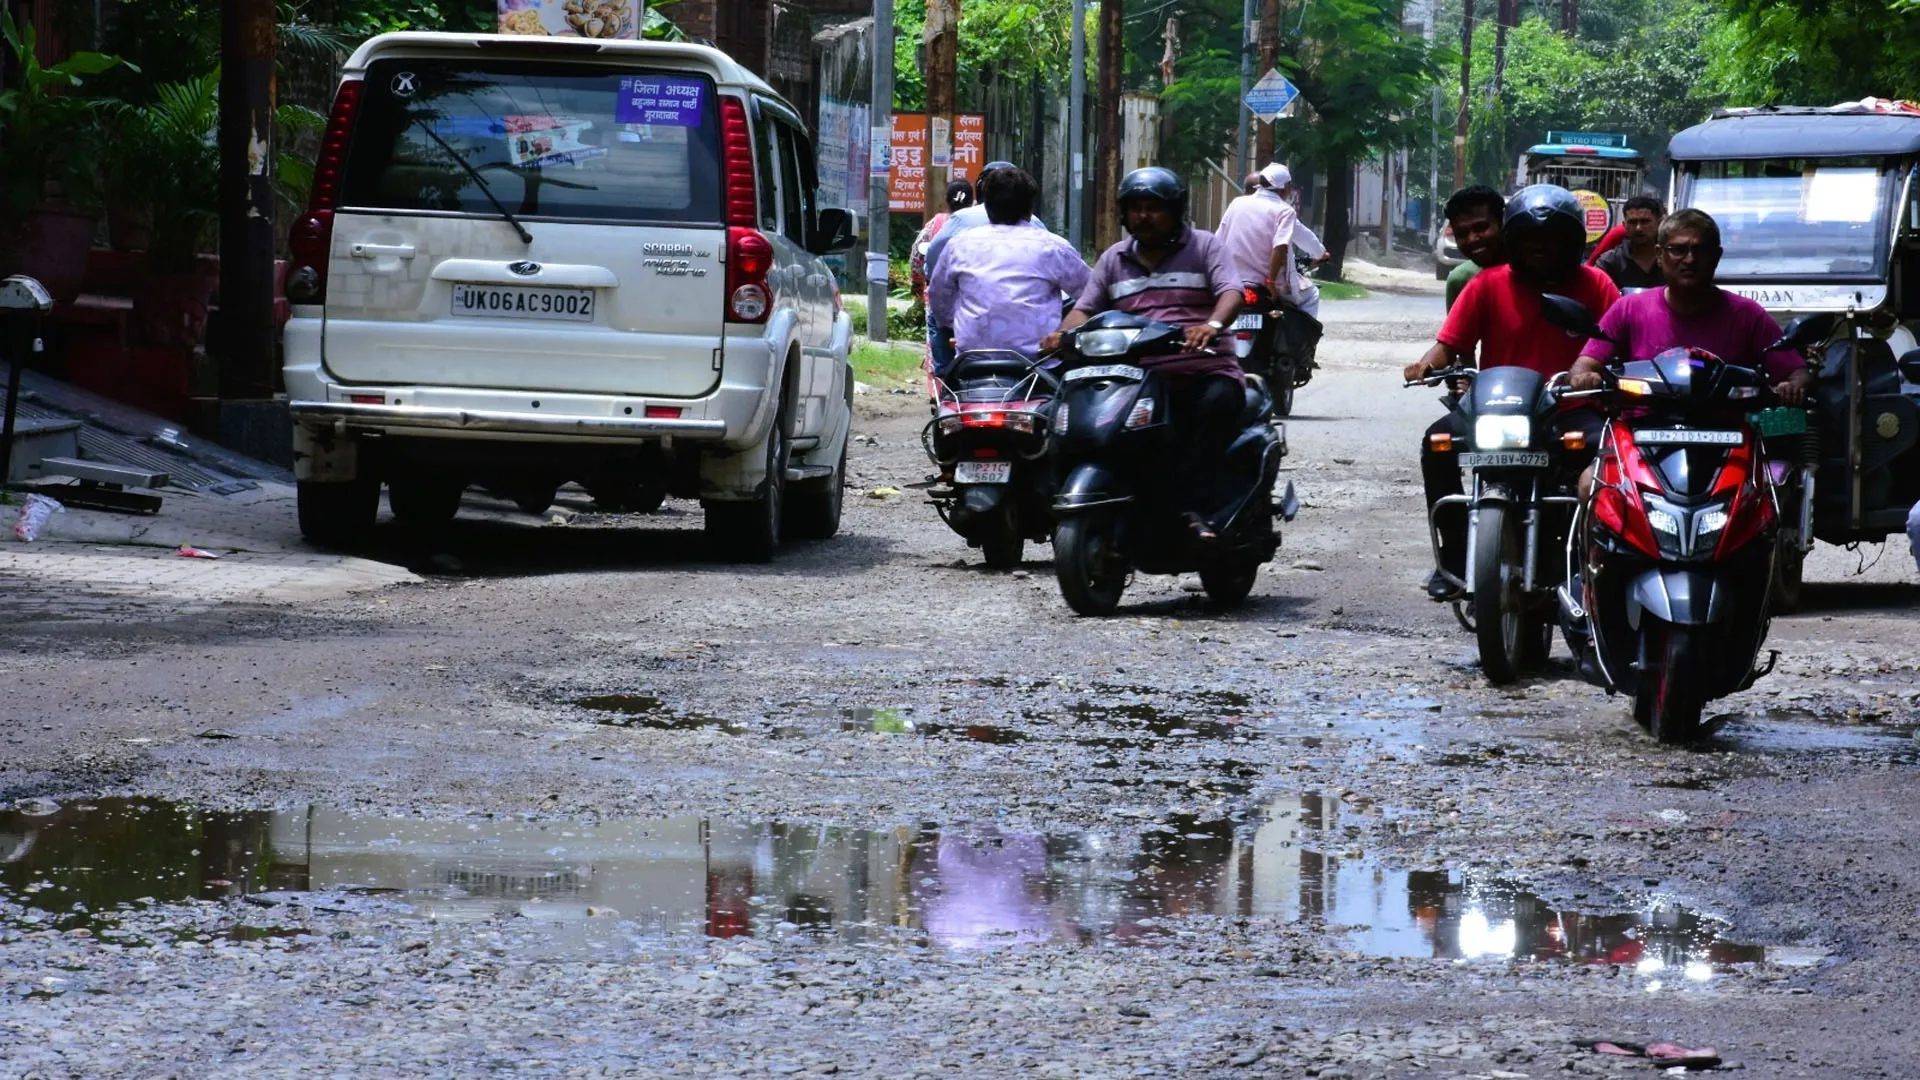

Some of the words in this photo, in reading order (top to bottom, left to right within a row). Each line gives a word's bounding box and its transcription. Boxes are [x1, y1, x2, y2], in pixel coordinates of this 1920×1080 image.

[633, 80, 660, 95] जिला
[665, 85, 699, 97] अध्यक्ष
[631, 97, 656, 109] बहुजन
[658, 99, 680, 108] समाज
[1560, 136, 1590, 145] METRO
[1591, 137, 1614, 145] RIDE
[1737, 290, 1795, 302] UDAAN
[464, 290, 591, 315] UK06AC9002
